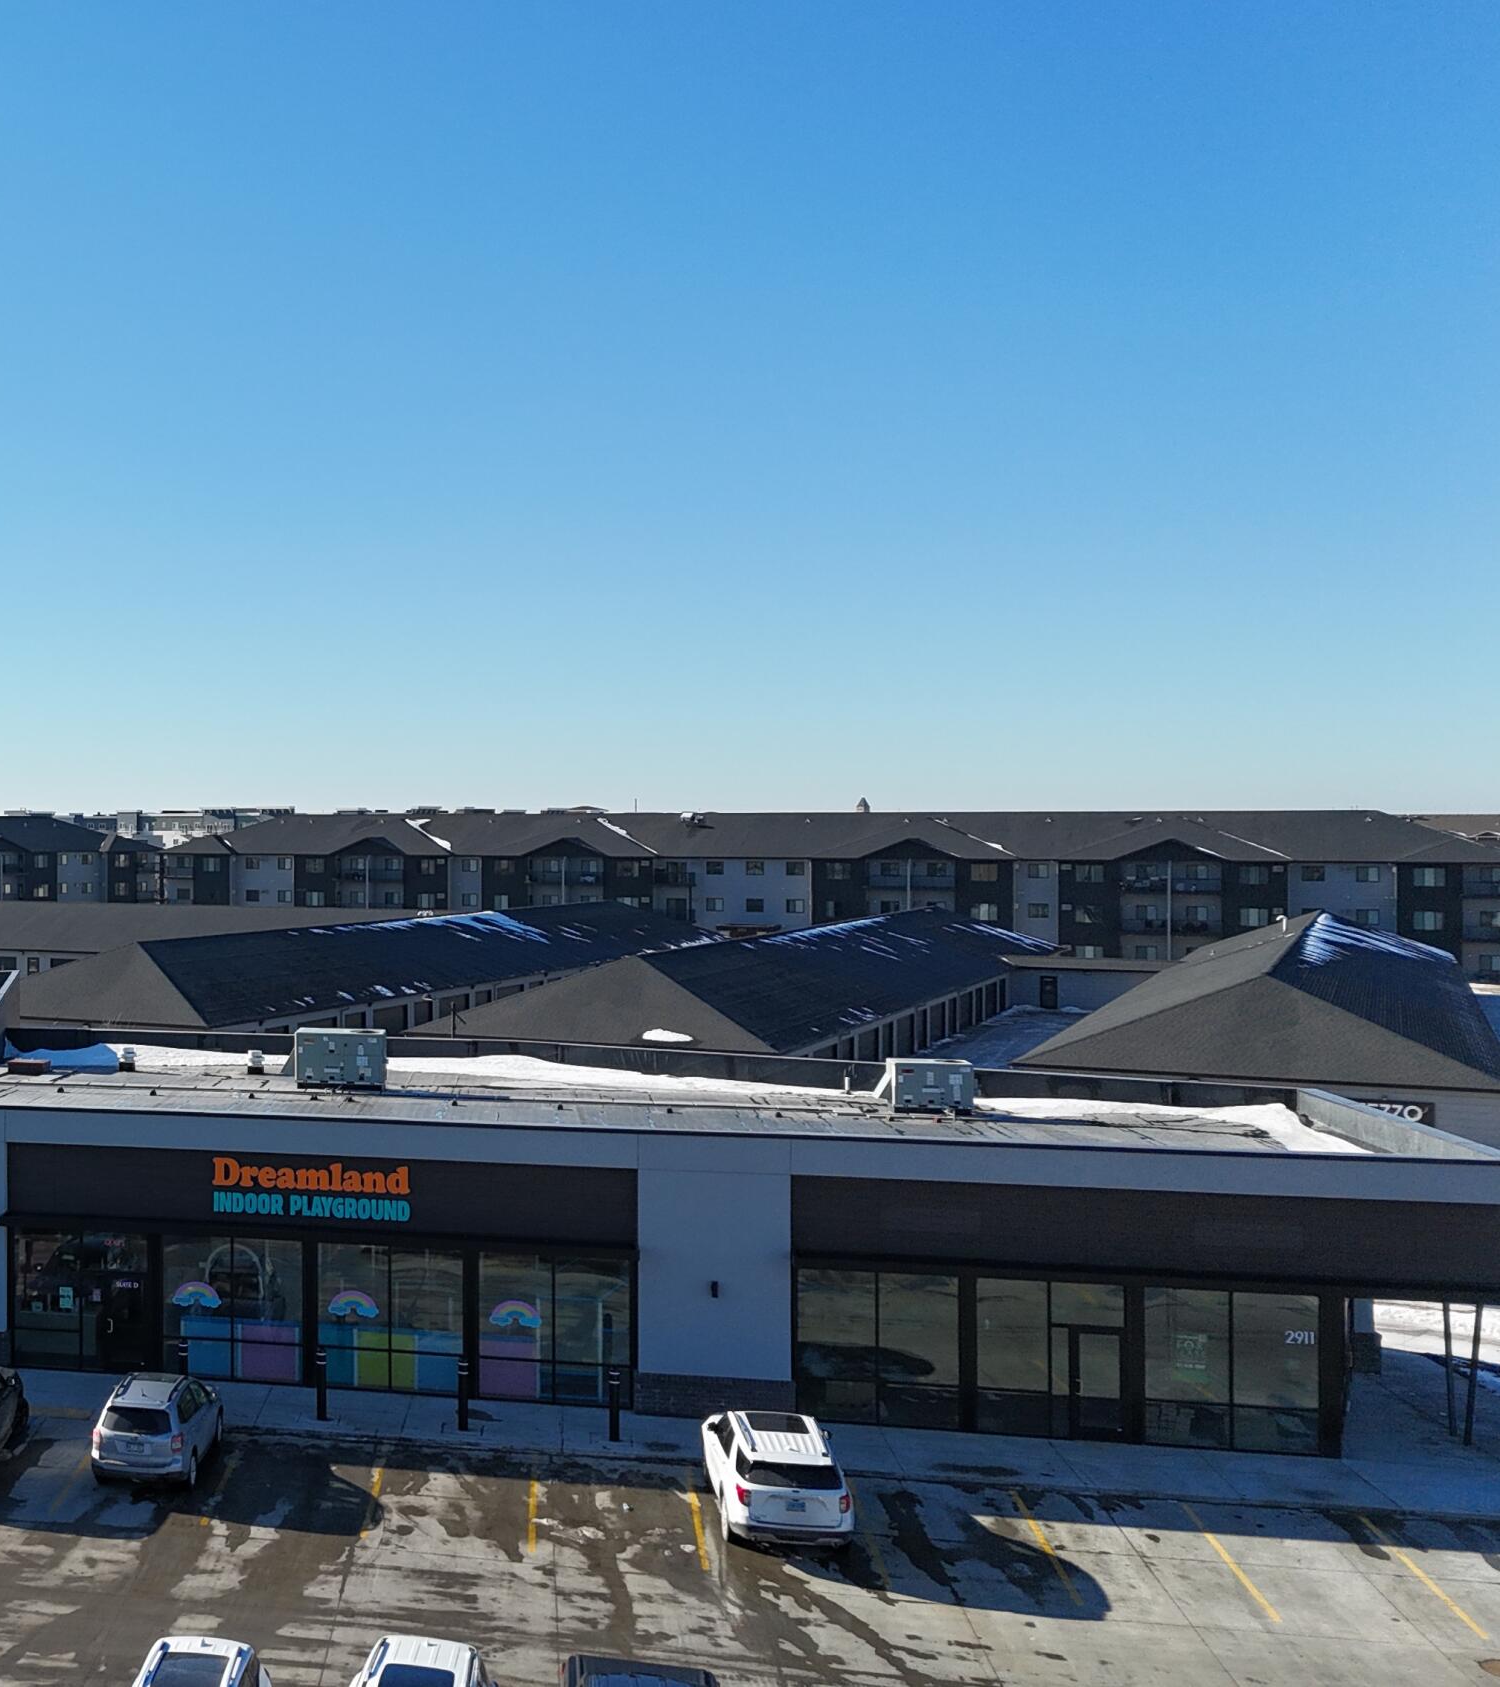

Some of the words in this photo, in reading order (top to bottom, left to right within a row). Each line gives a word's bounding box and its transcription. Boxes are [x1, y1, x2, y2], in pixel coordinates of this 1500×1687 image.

[212, 1157, 411, 1195] Dreamland
[213, 1191, 284, 1215] INDOOR
[290, 1194, 411, 1222] PLAYGROUND
[115, 1280, 132, 1288] SUITE
[1285, 1330, 1315, 1345] 2911
